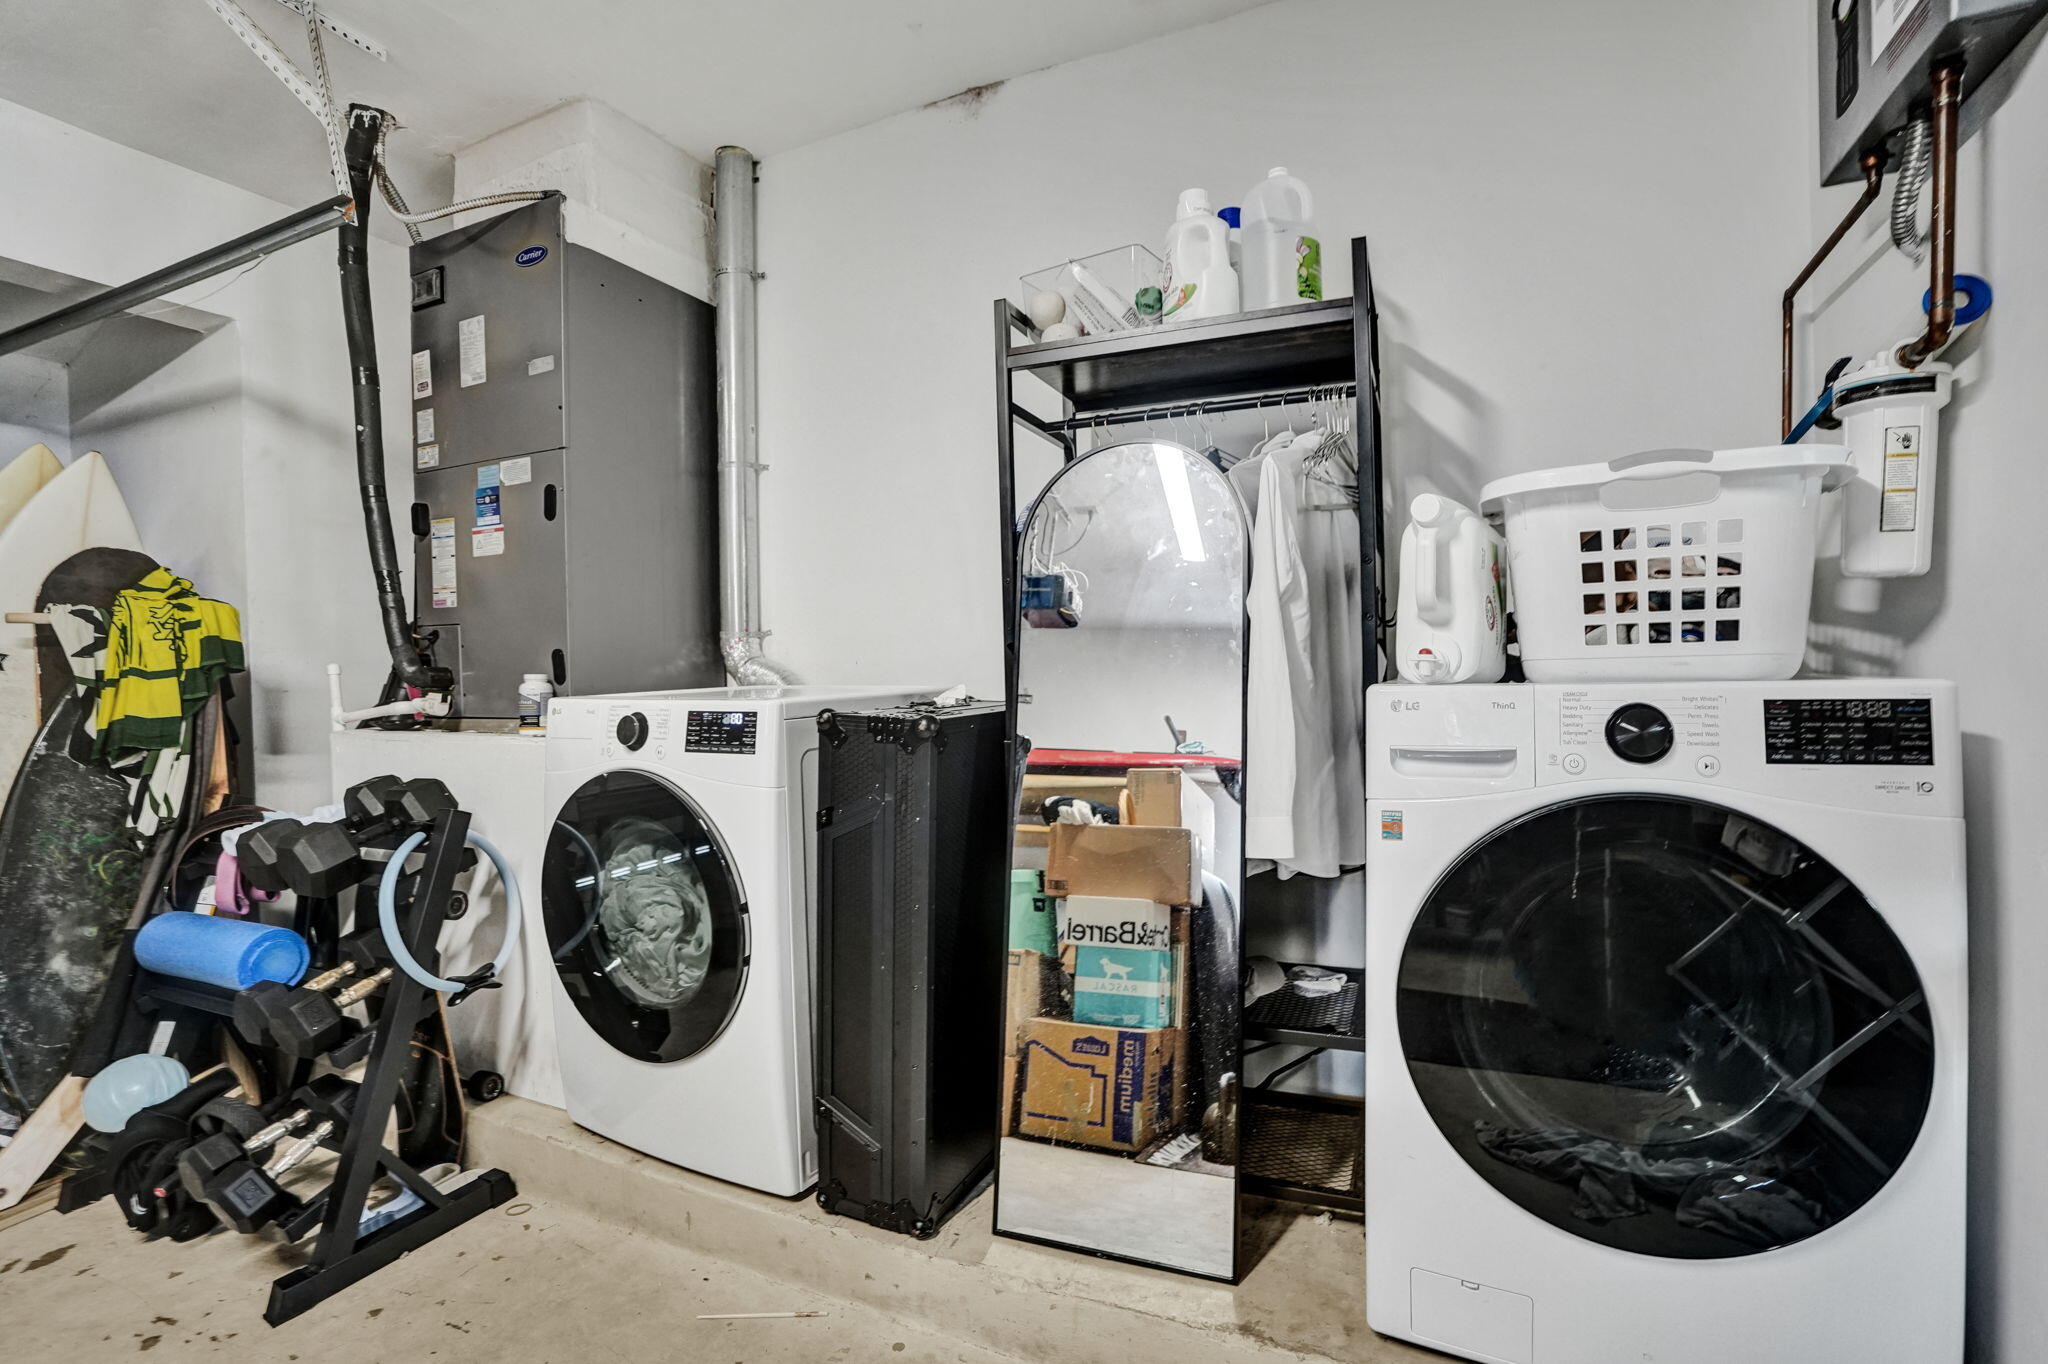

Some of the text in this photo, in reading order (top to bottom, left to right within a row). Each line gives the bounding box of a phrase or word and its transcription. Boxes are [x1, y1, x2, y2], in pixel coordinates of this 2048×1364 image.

[518, 249, 543, 263] Carrier
[1405, 701, 1421, 711] LG
[1491, 701, 1517, 710] ThinQ
